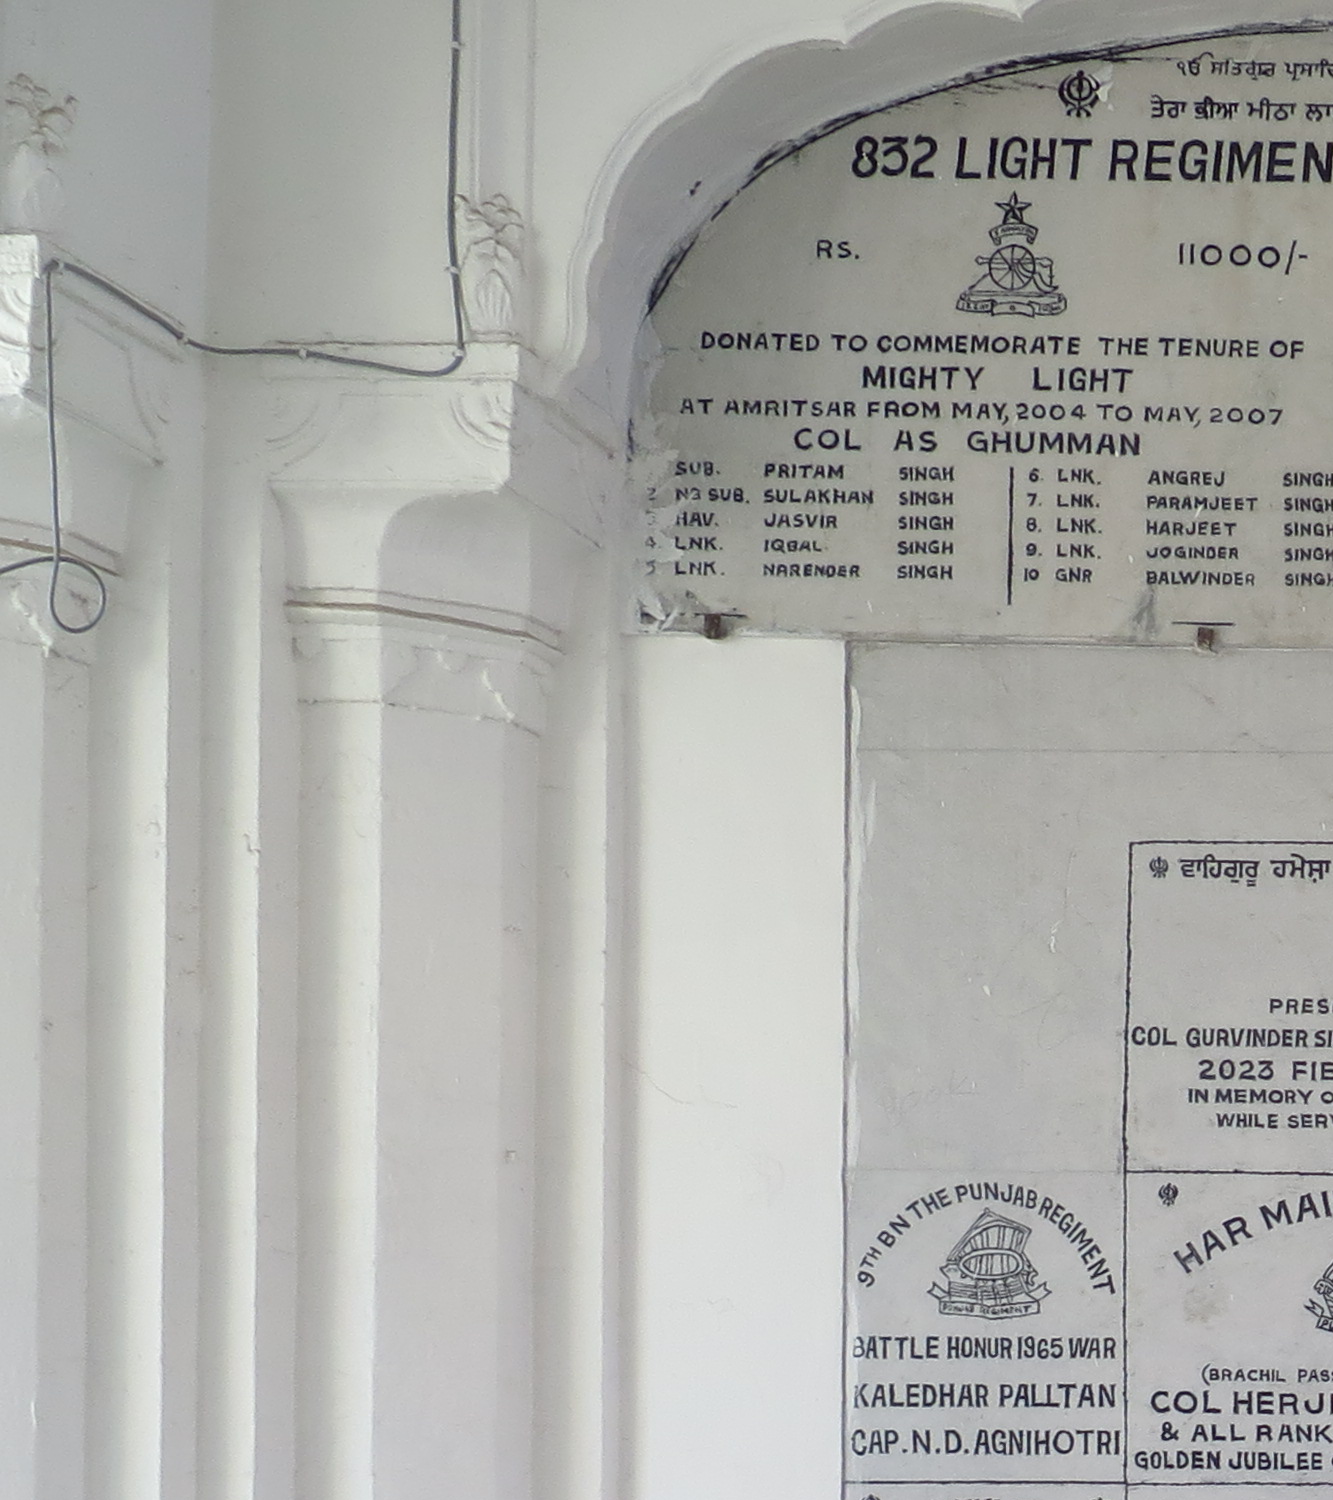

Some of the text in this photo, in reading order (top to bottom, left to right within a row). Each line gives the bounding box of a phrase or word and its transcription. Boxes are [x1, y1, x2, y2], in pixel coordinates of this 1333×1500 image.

[852, 135, 937, 178] 832
[955, 137, 1092, 180] LIGHT
[817, 240, 1307, 275] RS. 11000/-
[680, 399, 713, 414] AT
[725, 400, 856, 417] AMRITSAR
[868, 401, 940, 418] FROM
[1016, 403, 1086, 420] 2004
[1097, 404, 1132, 422] TO
[1210, 408, 1283, 425] 2007
[1147, 519, 1236, 536] HARJEET
[1199, 1059, 1273, 1080] 2023
[1188, 1089, 1209, 1103] IN
[1214, 1089, 1314, 1104] MEMORY
[1172, 1216, 1253, 1274] HAR
[853, 1336, 939, 1359] BATTLE
[1018, 1336, 1063, 1359] 1965
[1069, 1338, 1116, 1359] WAR
[1151, 1390, 1221, 1414] COL
